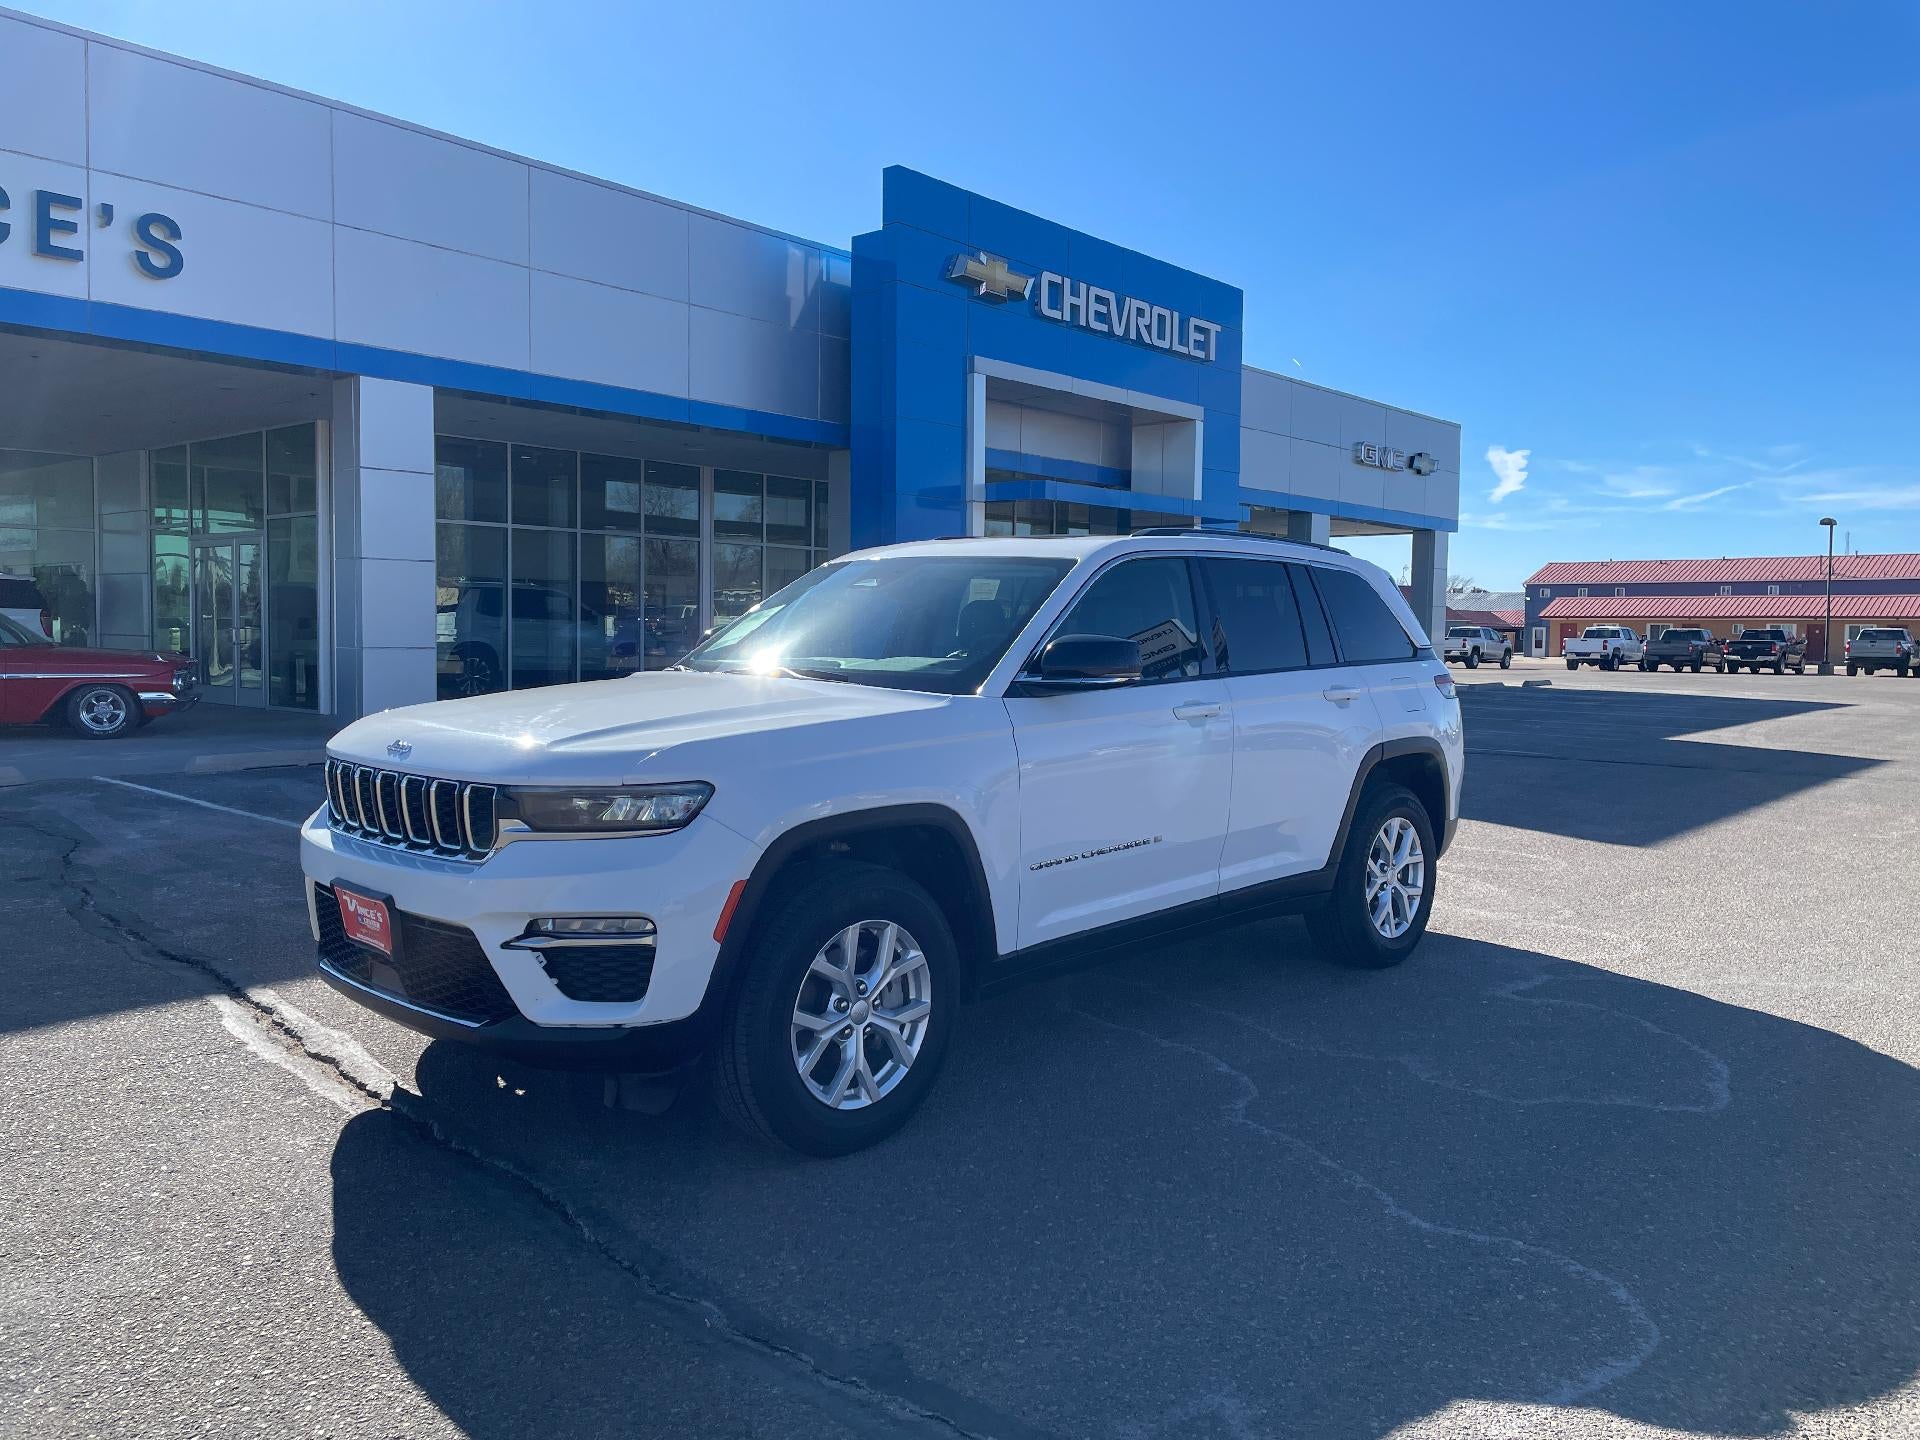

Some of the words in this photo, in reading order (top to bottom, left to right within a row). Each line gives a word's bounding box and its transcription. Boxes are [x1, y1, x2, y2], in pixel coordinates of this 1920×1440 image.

[0, 185, 184, 280] E'S
[1036, 270, 1222, 362] CHEVROLET
[1356, 441, 1405, 472] GMC
